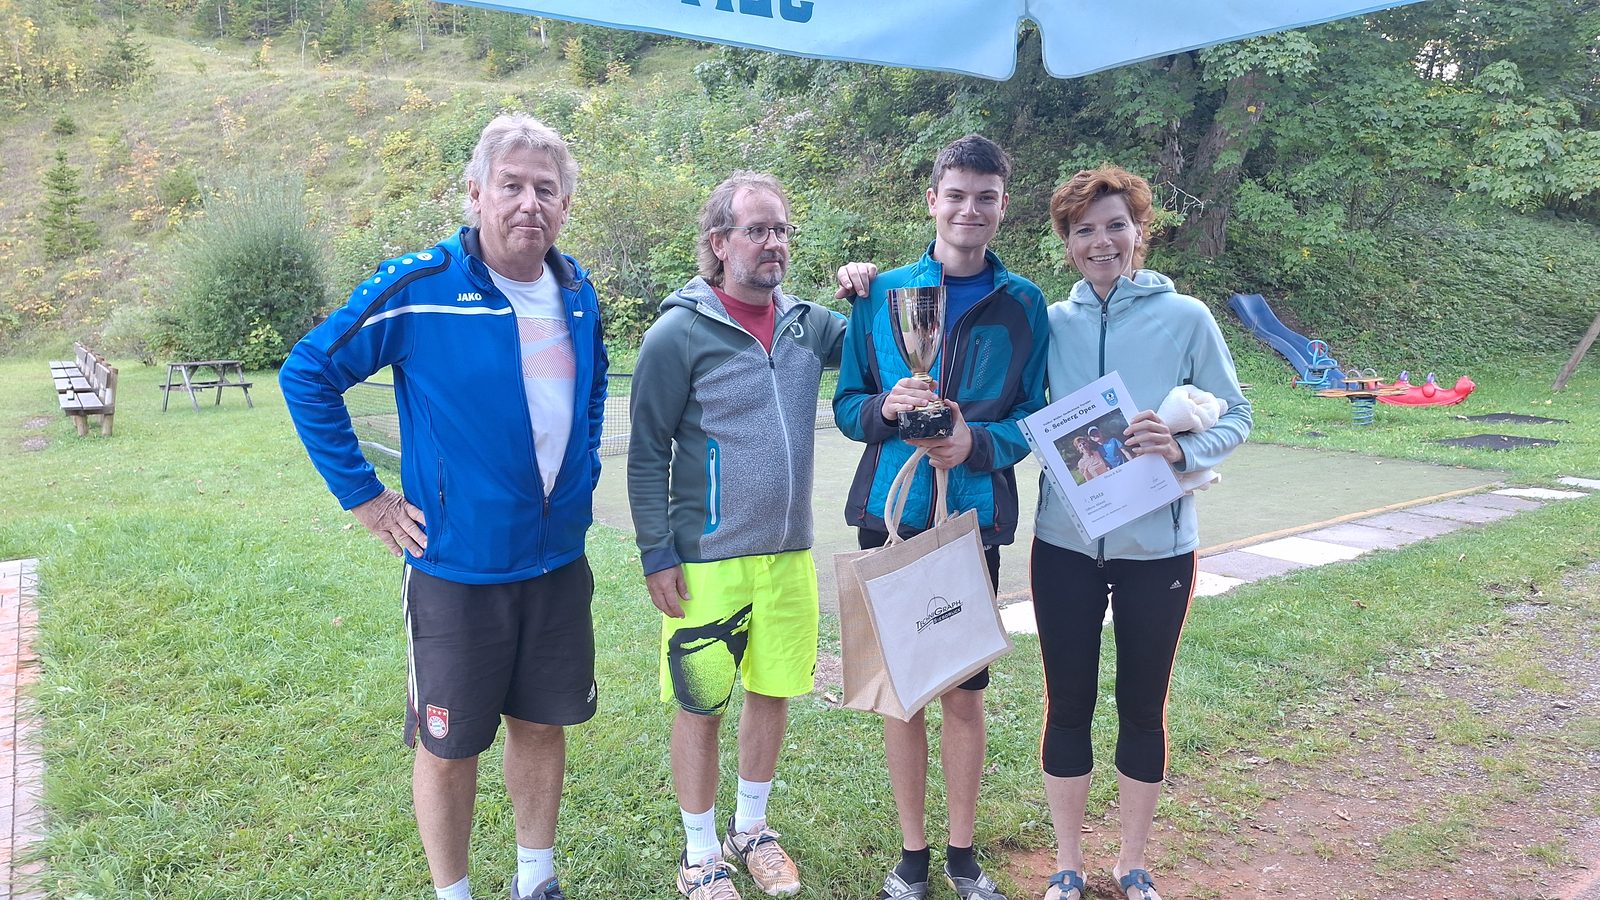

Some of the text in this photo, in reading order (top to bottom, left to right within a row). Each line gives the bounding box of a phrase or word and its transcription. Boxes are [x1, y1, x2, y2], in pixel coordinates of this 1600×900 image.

[456, 292, 482, 301] JAKO
[1052, 413, 1079, 430] Seeberg
[1078, 404, 1096, 415] Open
[1089, 491, 1104, 501] Platz
